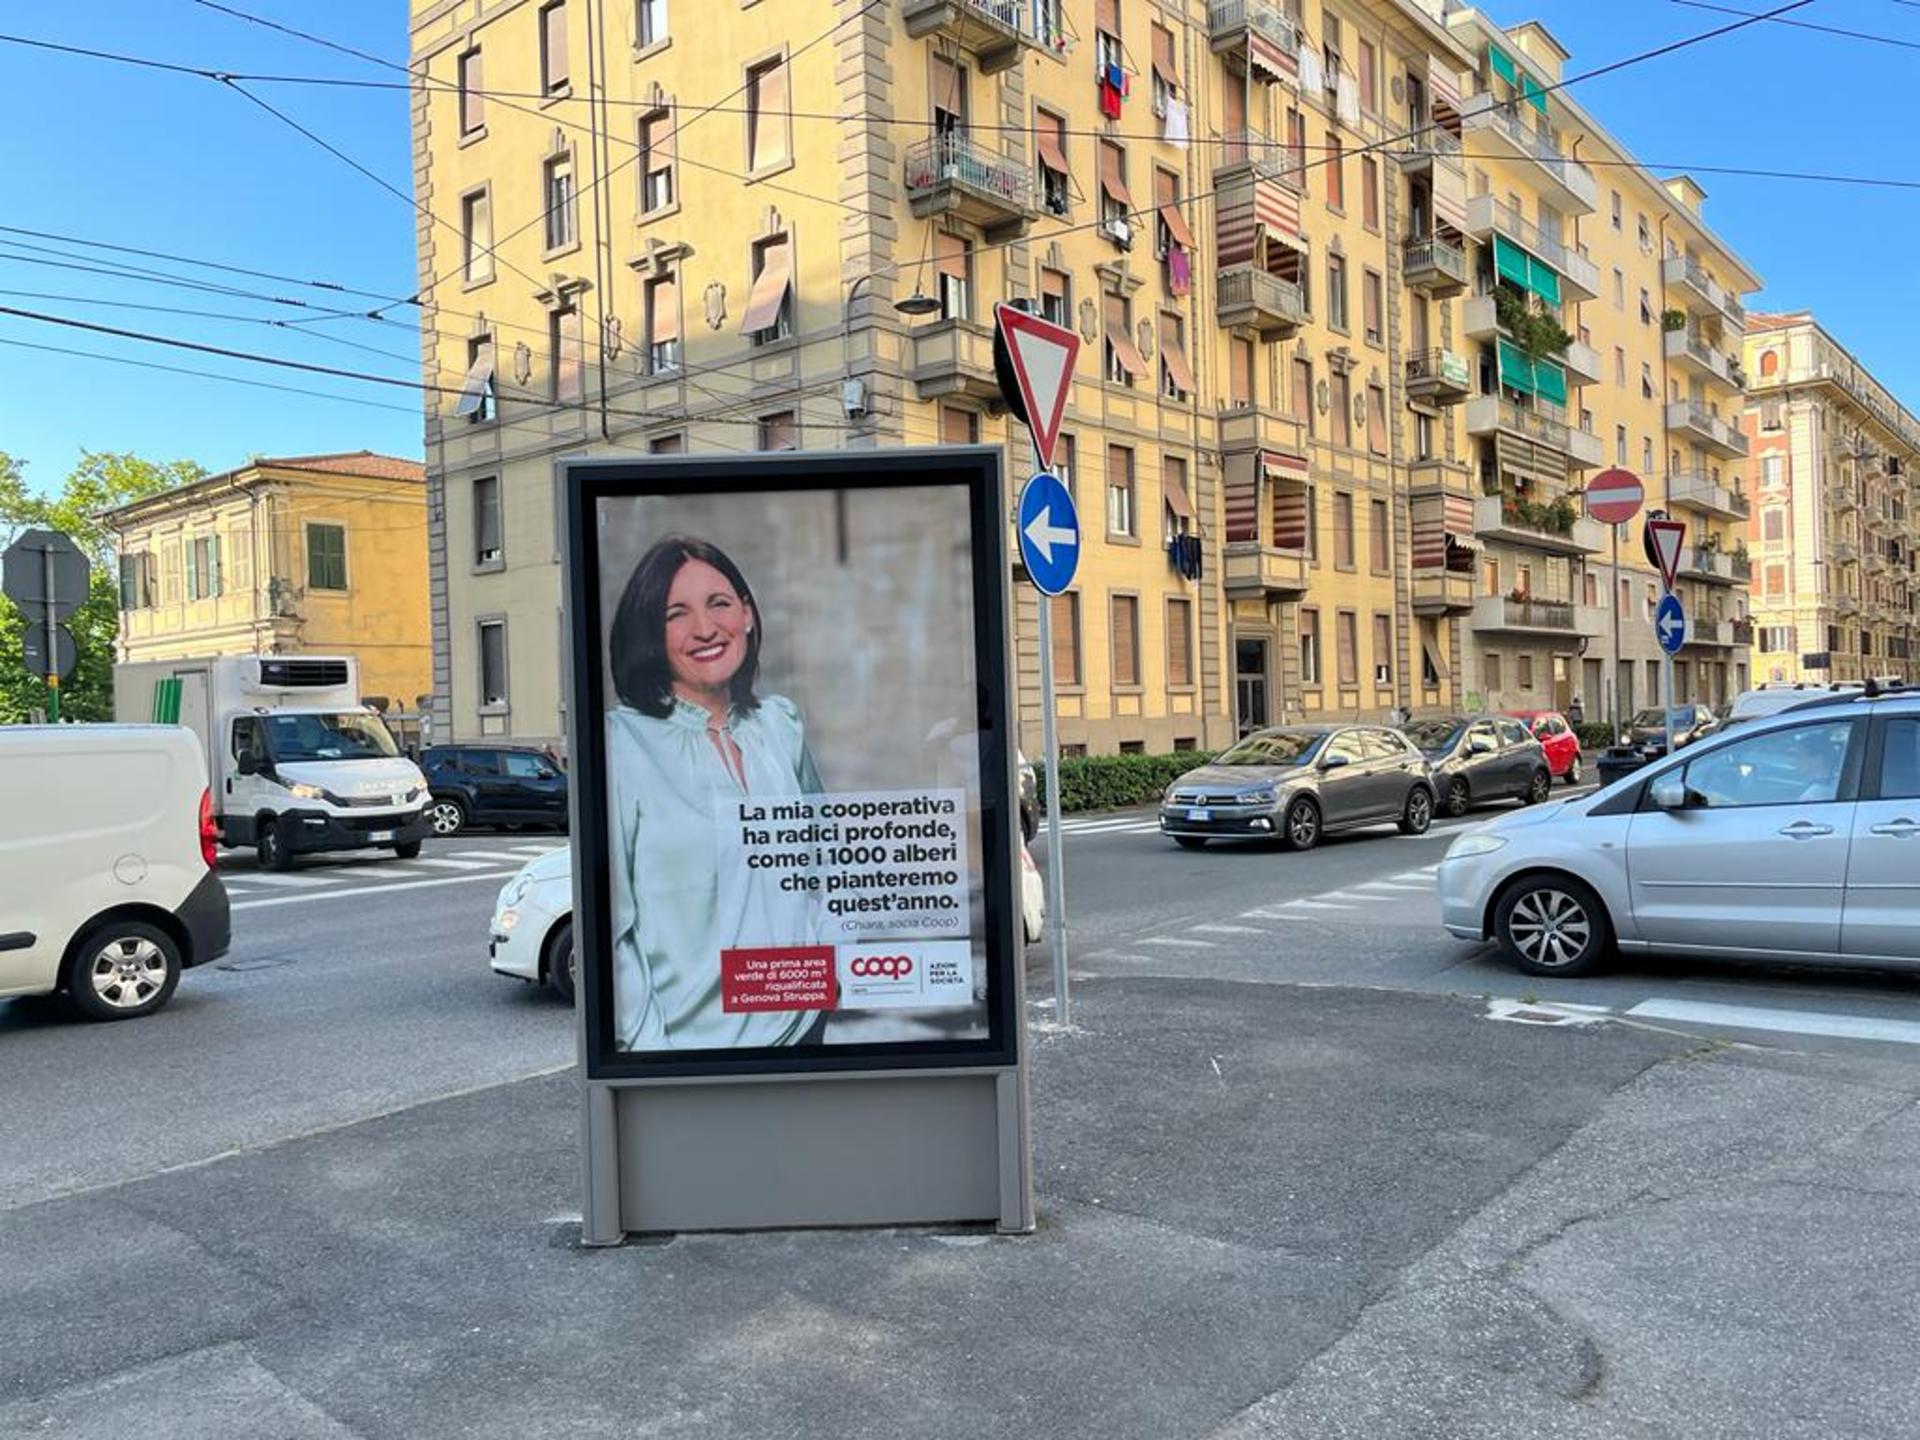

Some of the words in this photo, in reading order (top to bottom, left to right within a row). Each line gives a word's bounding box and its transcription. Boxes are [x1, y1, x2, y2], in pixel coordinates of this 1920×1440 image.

[739, 803, 766, 821] La
[772, 801, 814, 820] mia
[820, 796, 955, 820] cooperativa
[743, 825, 770, 845] ha
[776, 821, 839, 843] radici
[845, 820, 956, 843] profonde,
[747, 849, 810, 869] come
[816, 847, 822, 866] i
[828, 846, 887, 865] 1000
[893, 843, 957, 863] alberi
[780, 872, 821, 891] che
[826, 869, 958, 894] pianteremo
[828, 893, 959, 916] quest'anno.
[841, 918, 886, 932] (Chiara,
[888, 919, 919, 929] socia
[921, 916, 959, 928] Coop)
[734, 972, 764, 981] verde
[766, 971, 777, 980] di
[779, 970, 808, 980] 6000
[746, 961, 768, 970] Una
[770, 960, 801, 970] prima
[851, 956, 912, 980] coop
[764, 980, 828, 991] riqualificata
[731, 996, 739, 1004] a
[740, 993, 781, 1003] Genova
[783, 991, 827, 1001] Struppa.
